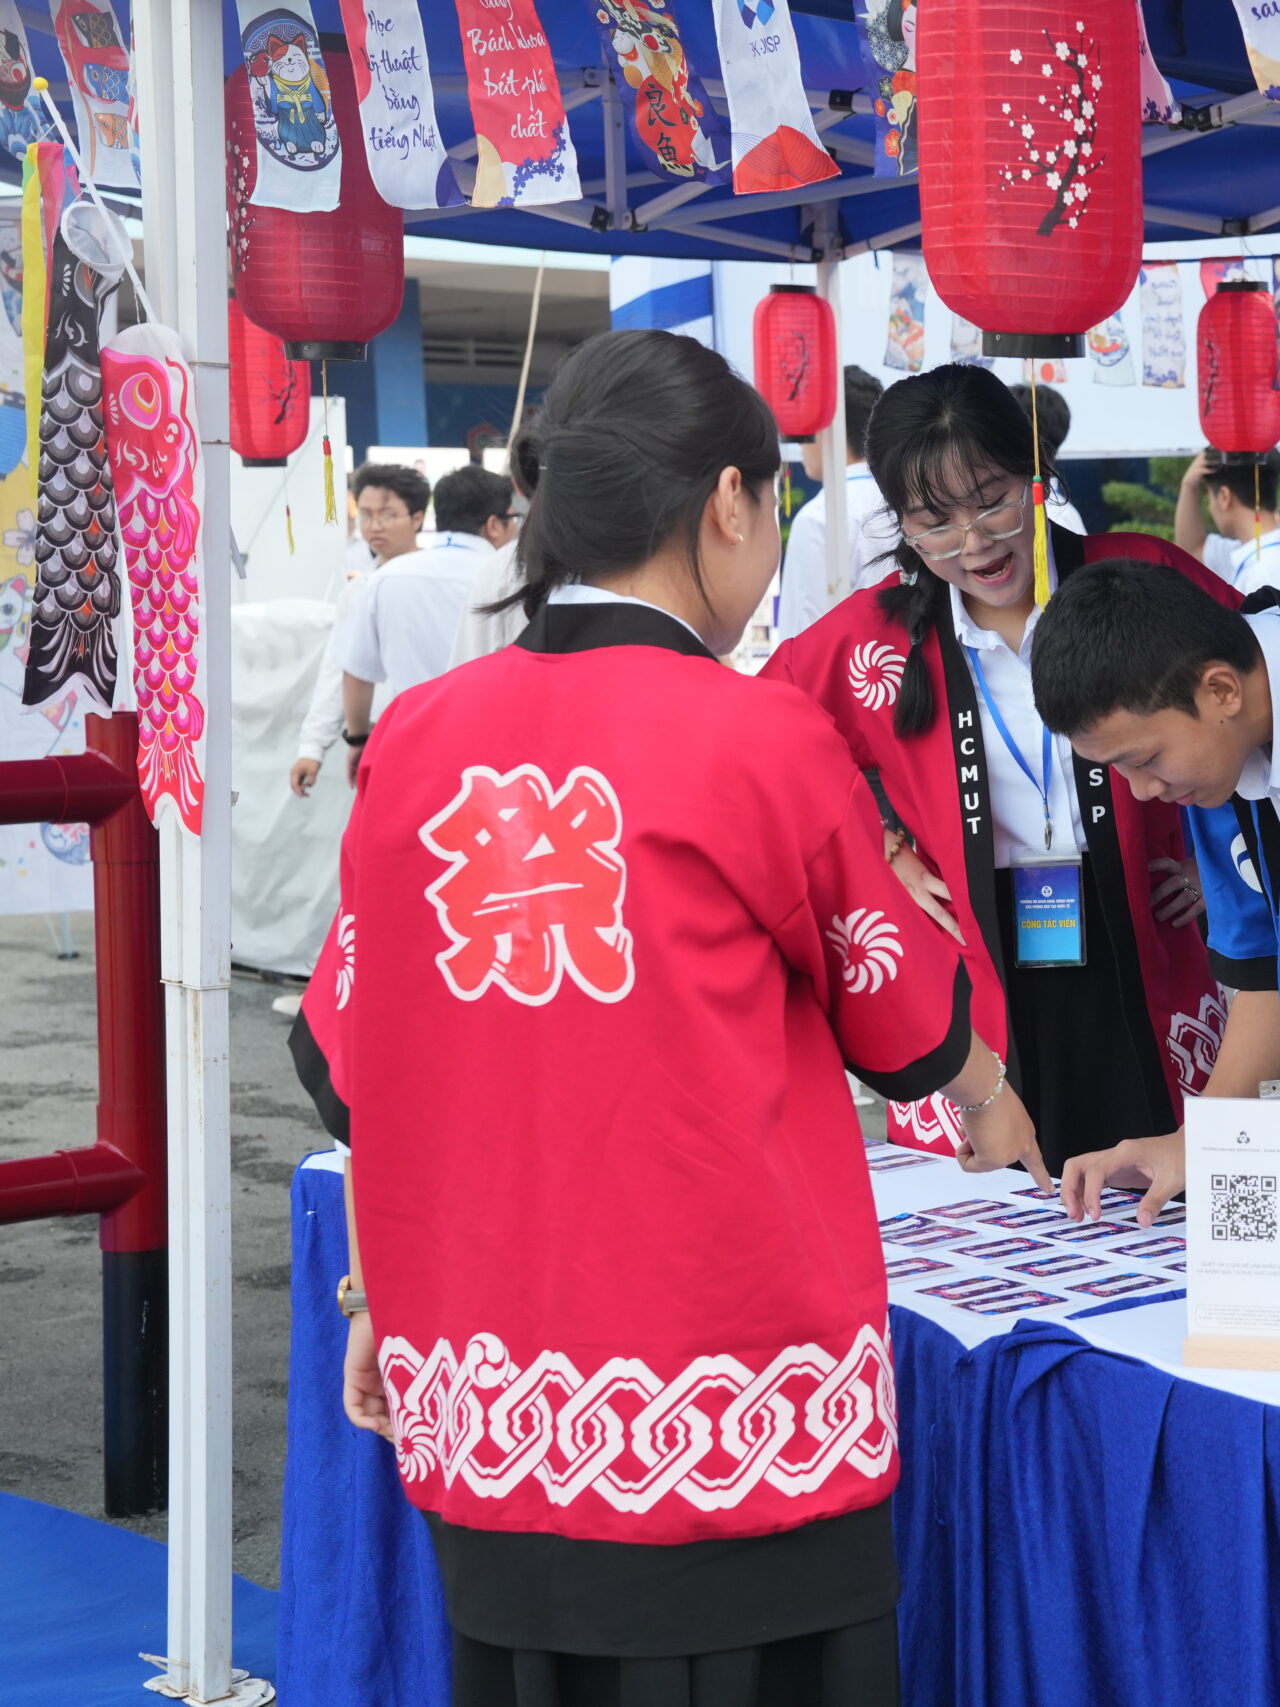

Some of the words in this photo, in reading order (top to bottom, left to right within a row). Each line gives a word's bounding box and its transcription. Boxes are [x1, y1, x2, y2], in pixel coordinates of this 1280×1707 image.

[368, 10, 395, 37] Học
[466, 27, 514, 56] Bách
[508, 22, 546, 49] khoa
[380, 46, 423, 74] thuật
[382, 85, 420, 121] bằng
[510, 108, 549, 139] chất
[369, 126, 410, 160] tiếng
[958, 710, 982, 835] HCMUT
[1022, 918, 1042, 928] CÔNG
[1044, 917, 1057, 928] TÁC
[1060, 917, 1076, 928] VIÊN
